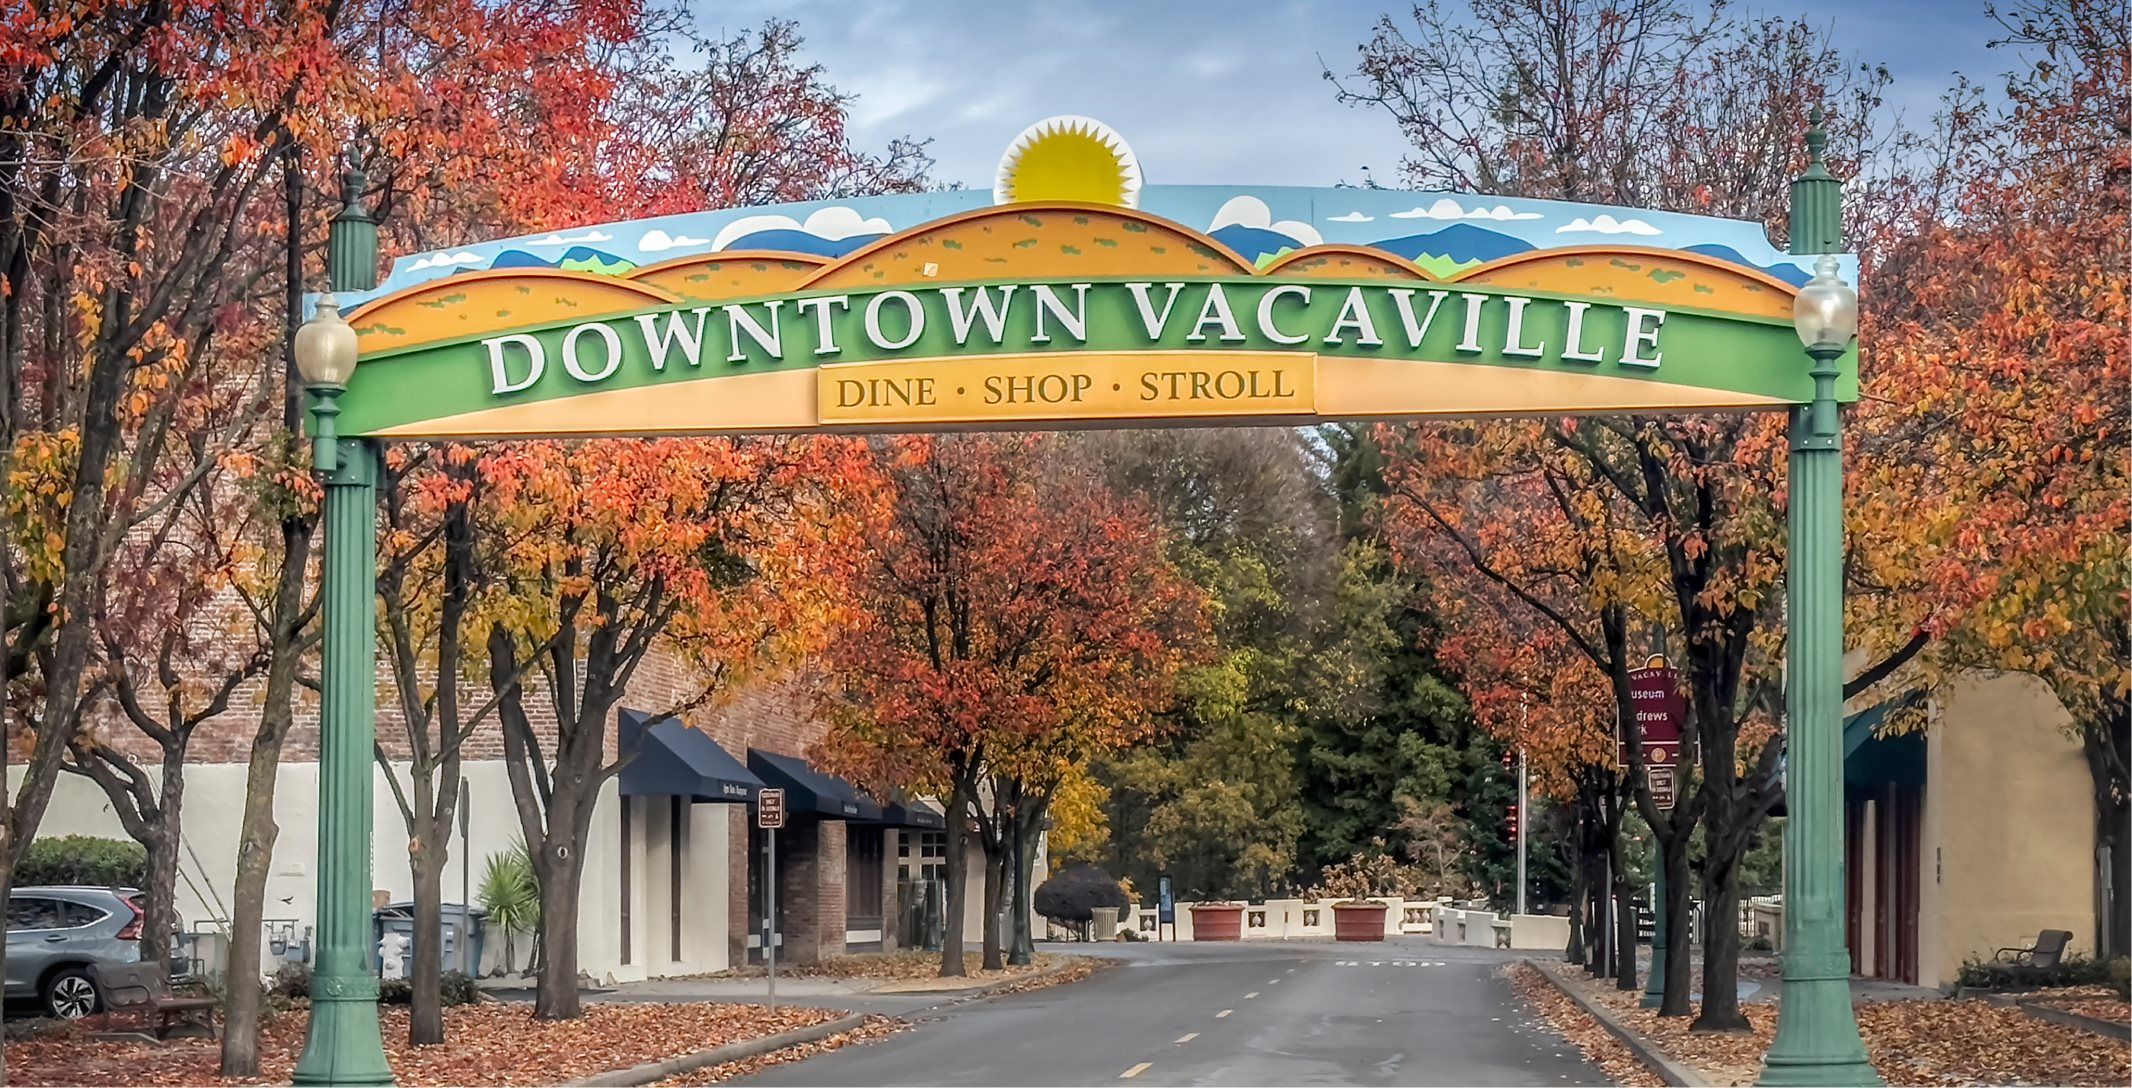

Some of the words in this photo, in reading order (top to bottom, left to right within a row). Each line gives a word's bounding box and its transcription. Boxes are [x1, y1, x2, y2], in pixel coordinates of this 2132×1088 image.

[481, 282, 1092, 396] DOWNTOWN
[1125, 282, 1668, 369] VACAVILLE
[836, 377, 937, 408] DINE
[983, 374, 1092, 405] SHOP
[1140, 369, 1295, 402] STROLL
[1631, 690, 1665, 700] useum
[1636, 709, 1668, 721] drews
